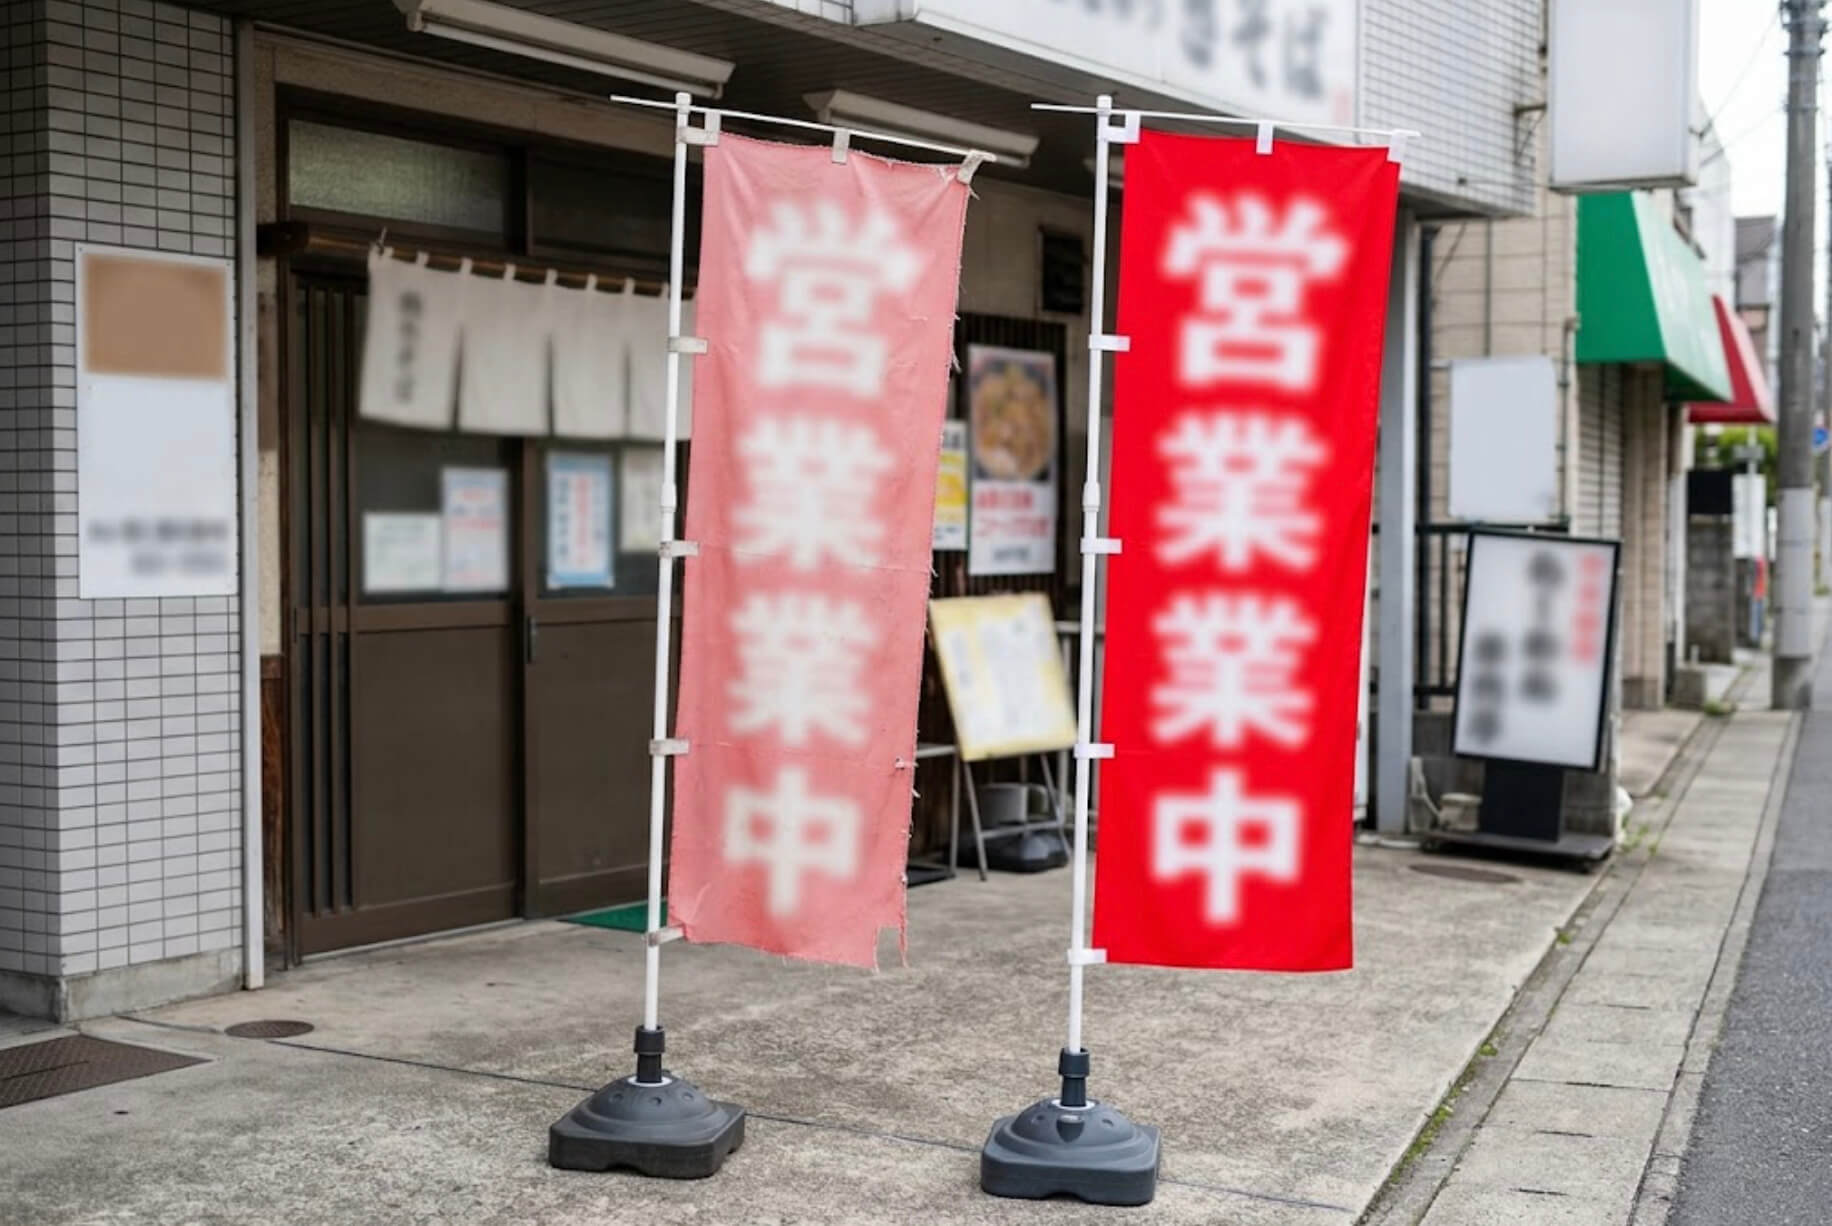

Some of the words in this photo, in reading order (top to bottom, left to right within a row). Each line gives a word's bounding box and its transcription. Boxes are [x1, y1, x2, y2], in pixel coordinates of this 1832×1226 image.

[724, 198, 924, 917] 営業業中
[1152, 194, 1349, 923] 営業業中
